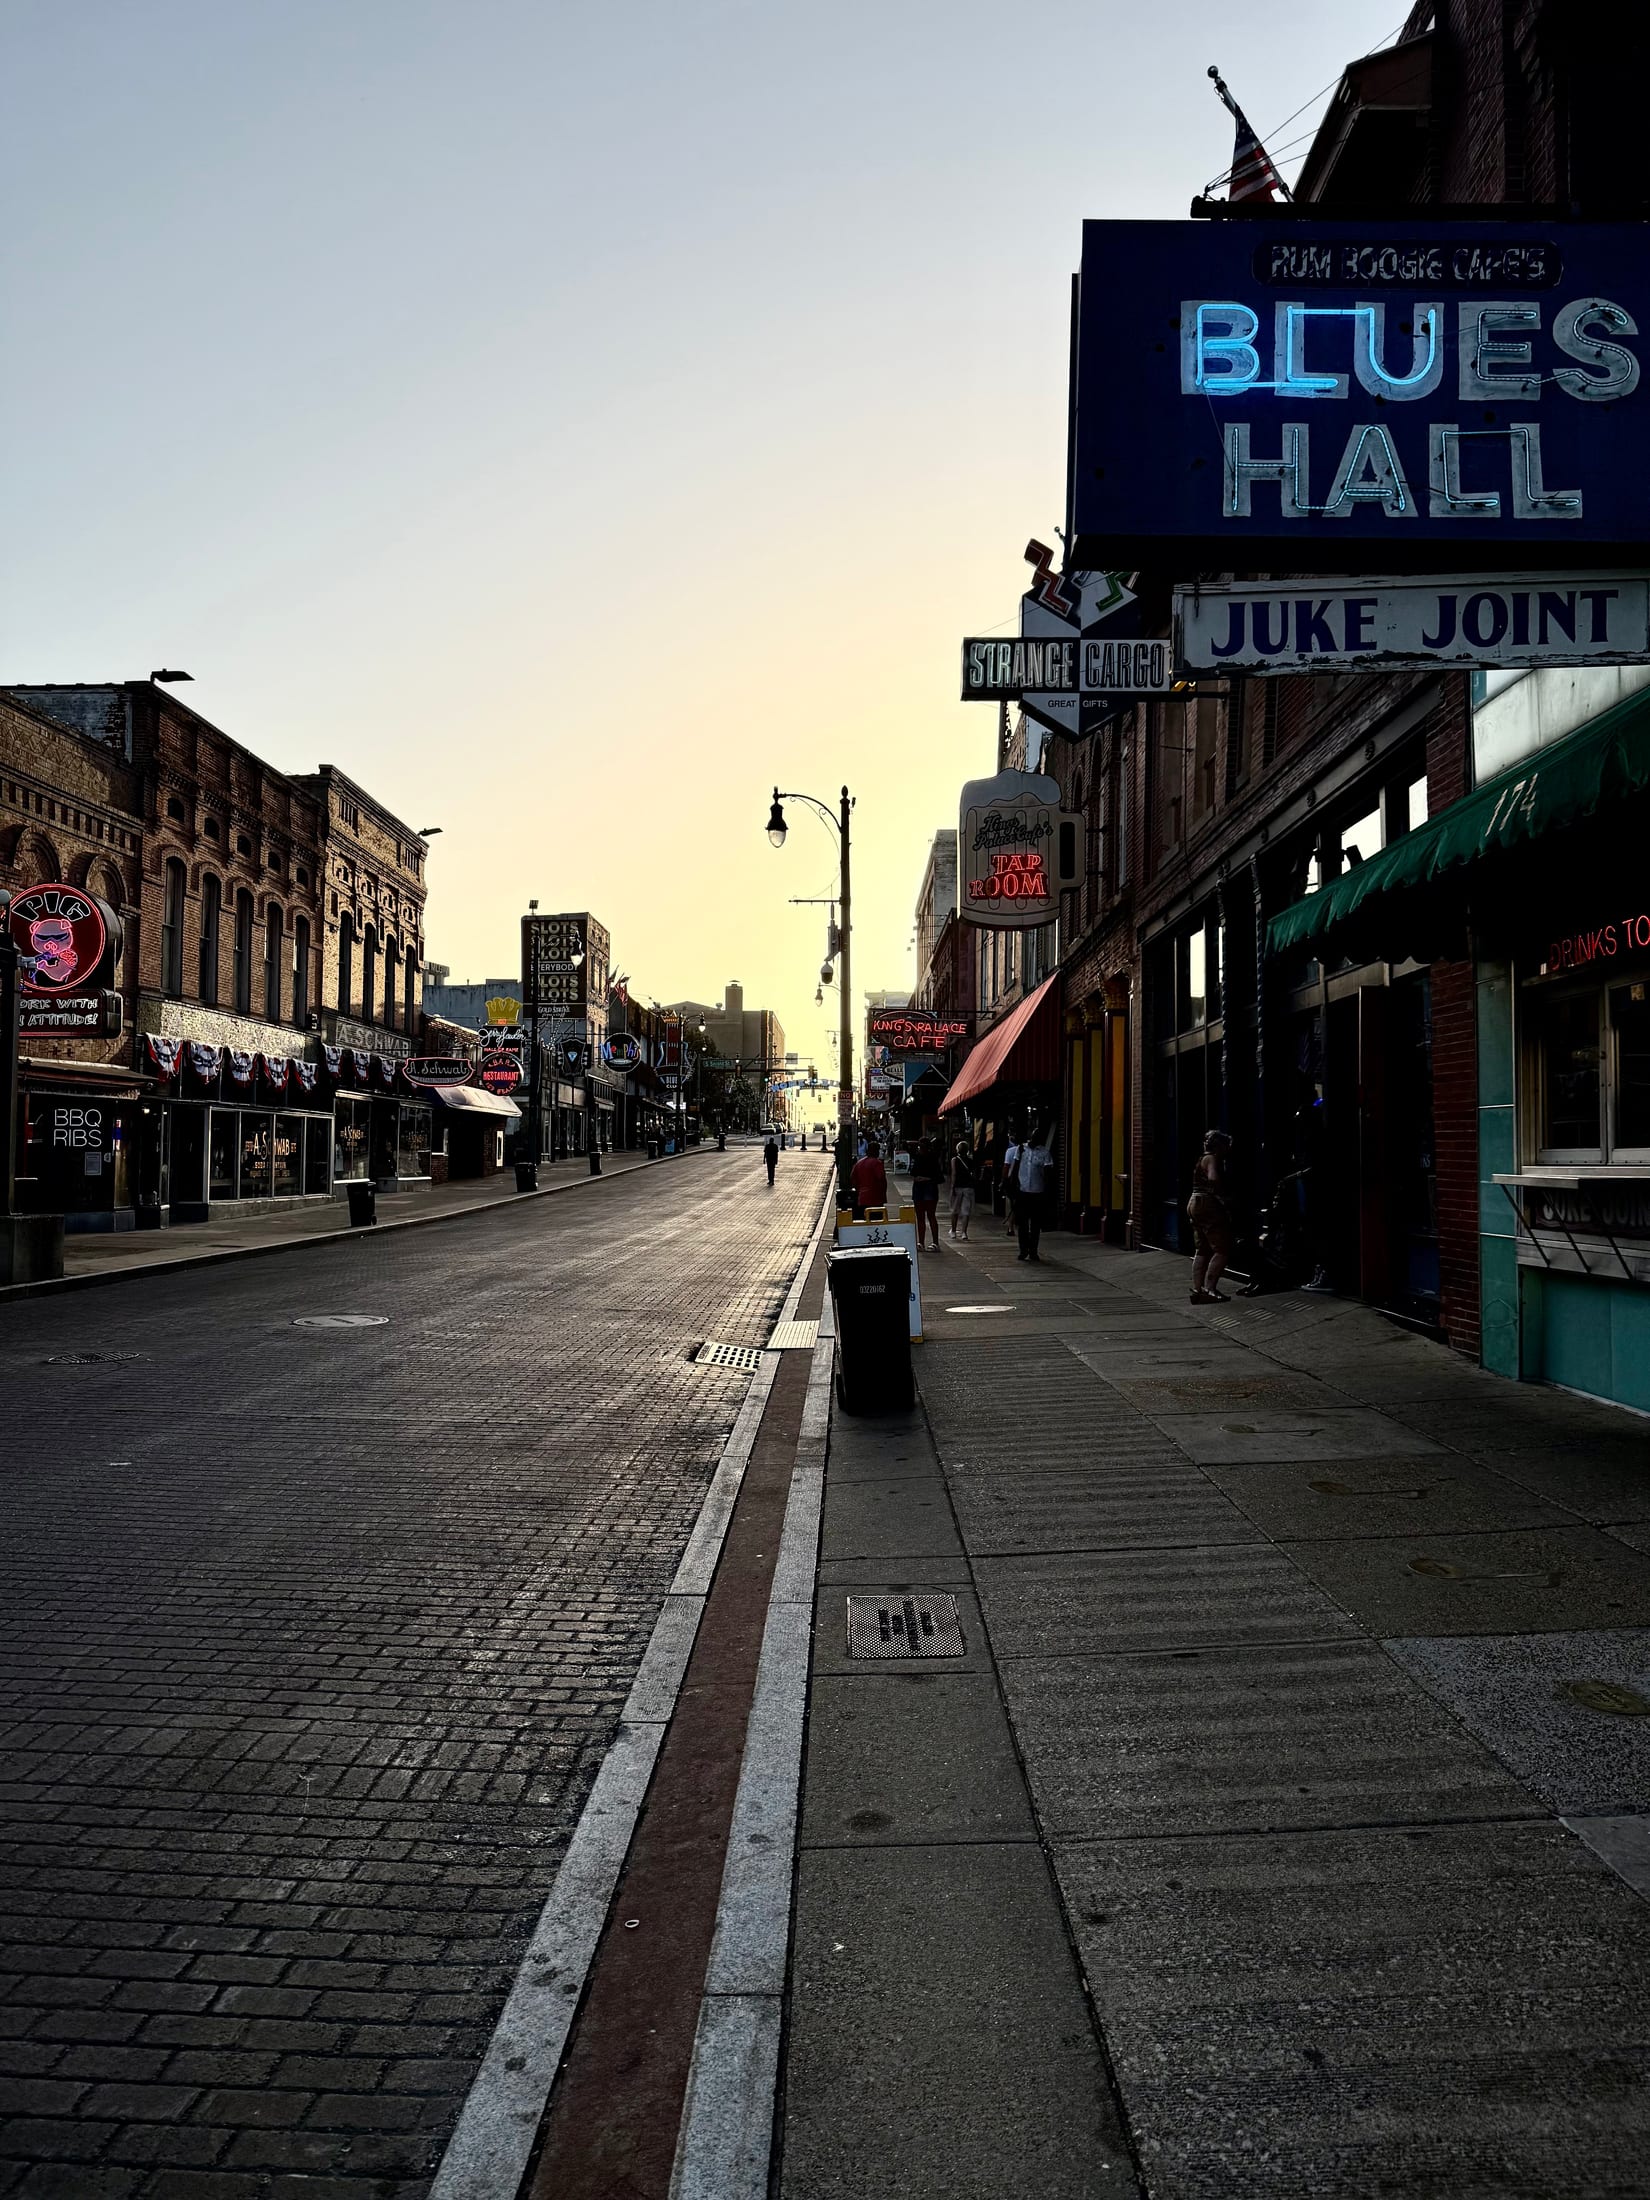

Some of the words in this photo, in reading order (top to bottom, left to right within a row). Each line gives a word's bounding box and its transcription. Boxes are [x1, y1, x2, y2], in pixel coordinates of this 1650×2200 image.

[1271, 245, 1331, 279] RUM
[1342, 247, 1442, 280] BOOGIE
[1180, 297, 1641, 401] BLUES
[1223, 423, 1583, 519] HALL
[1210, 597, 1378, 657] JUKE
[1422, 589, 1619, 648] JOINT
[969, 642, 1073, 689] STRANGE
[1085, 642, 1165, 688] CARGO
[1047, 700, 1077, 708] GREAT
[1082, 700, 1108, 708] GIFTS
[1484, 773, 1539, 837] 174
[992, 854, 1041, 875] TAP
[969, 872, 1047, 897] ROOM
[12, 891, 91, 922] PIG
[530, 921, 579, 934] SLOTS
[1548, 926, 1617, 970] DRINKS
[1621, 915, 1650, 949] TO
[20, 998, 51, 1010] ORK
[56, 998, 98, 1010] WITH
[28, 1013, 98, 1027] ATTITUDE!
[353, 1027, 410, 1058] SCHWAB
[892, 1035, 945, 1049] CAFE
[421, 1060, 470, 1075] Schwab
[483, 1071, 519, 1081] RESTAURANT
[54, 1108, 102, 1127] BBQ
[53, 1128, 102, 1147] RIBS
